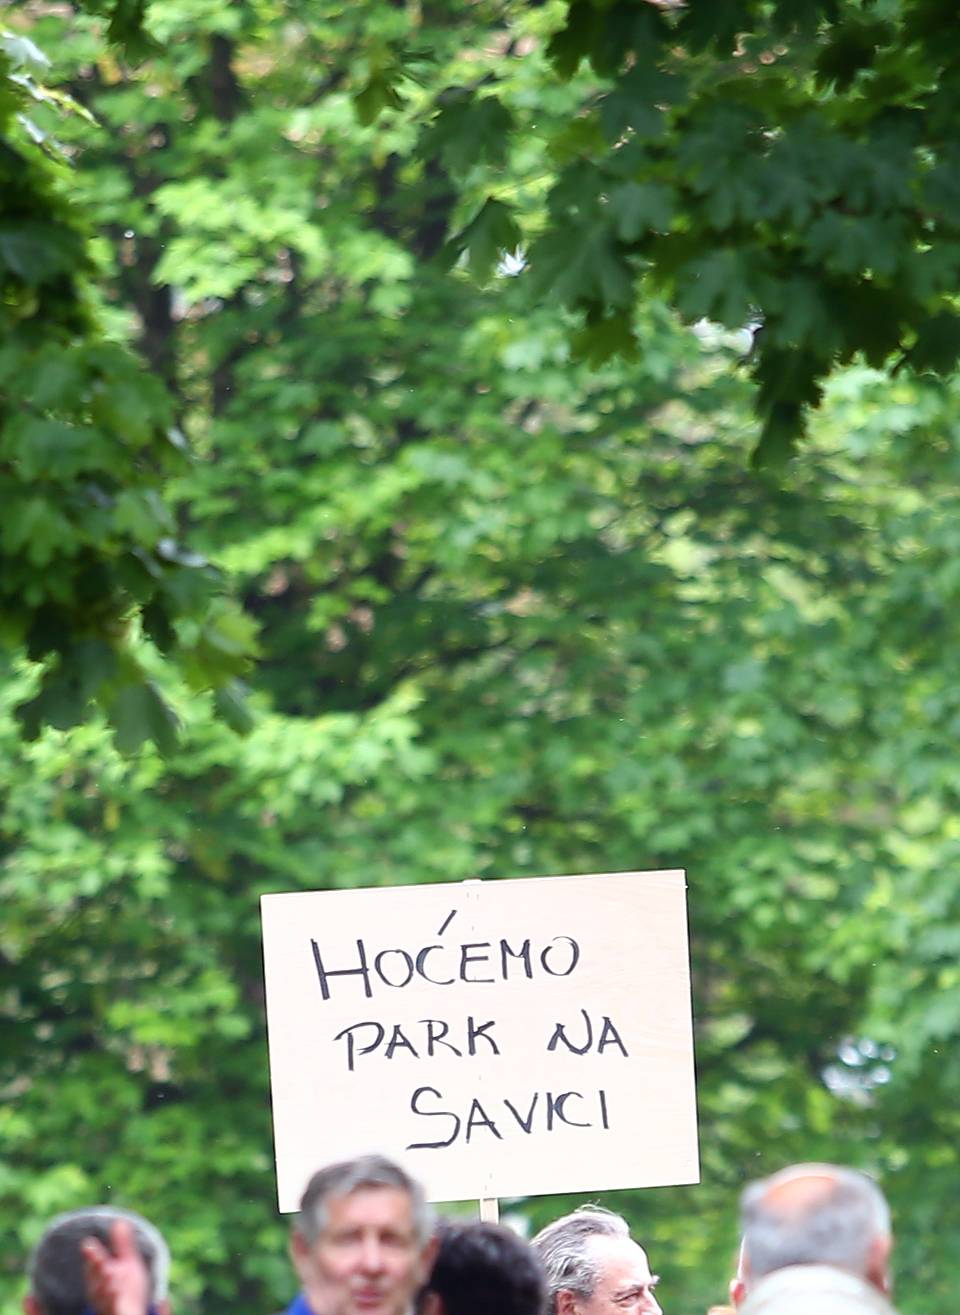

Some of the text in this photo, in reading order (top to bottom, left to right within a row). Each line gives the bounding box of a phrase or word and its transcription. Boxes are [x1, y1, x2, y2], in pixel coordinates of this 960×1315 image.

[310, 909, 580, 1001] HOĆEMO
[333, 1008, 629, 1071] PARK NA
